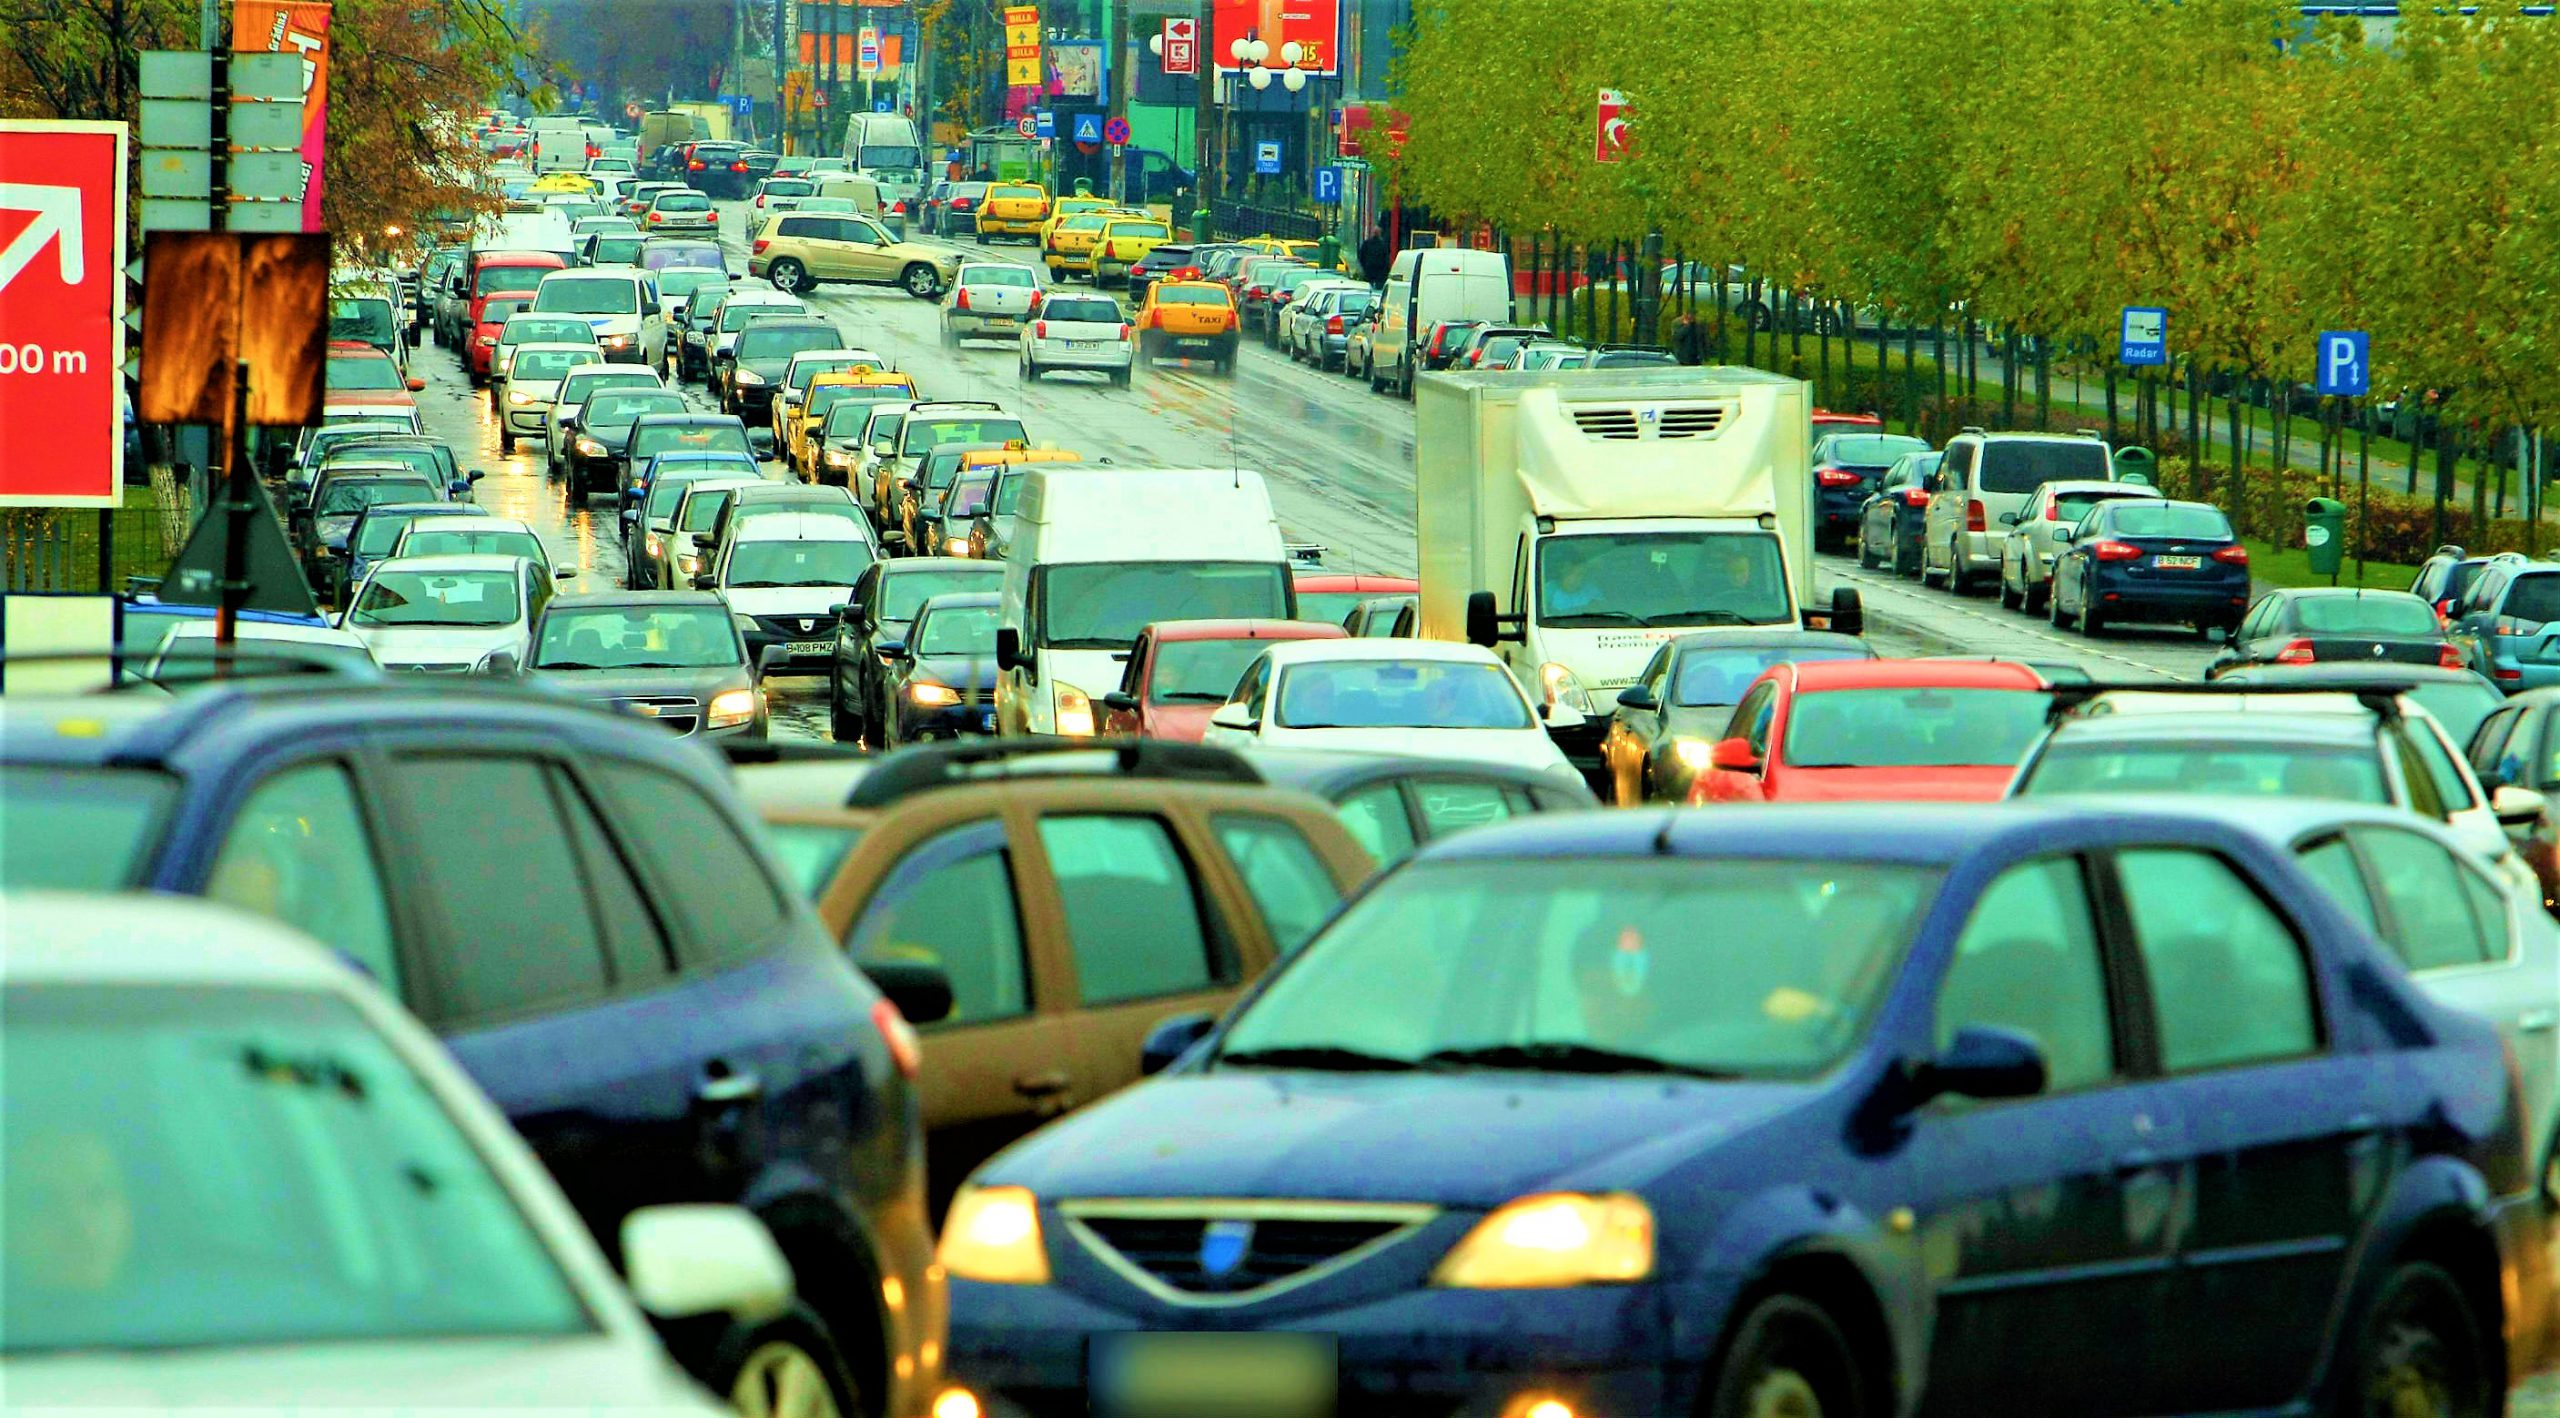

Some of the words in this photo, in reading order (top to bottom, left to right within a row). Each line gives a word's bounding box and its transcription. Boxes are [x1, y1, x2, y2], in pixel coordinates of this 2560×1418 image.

[1022, 120, 1036, 133] 60
[1320, 170, 1334, 198] P
[53, 351, 87, 374] m
[2125, 347, 2158, 359] Radar
[2328, 337, 2355, 387] P
